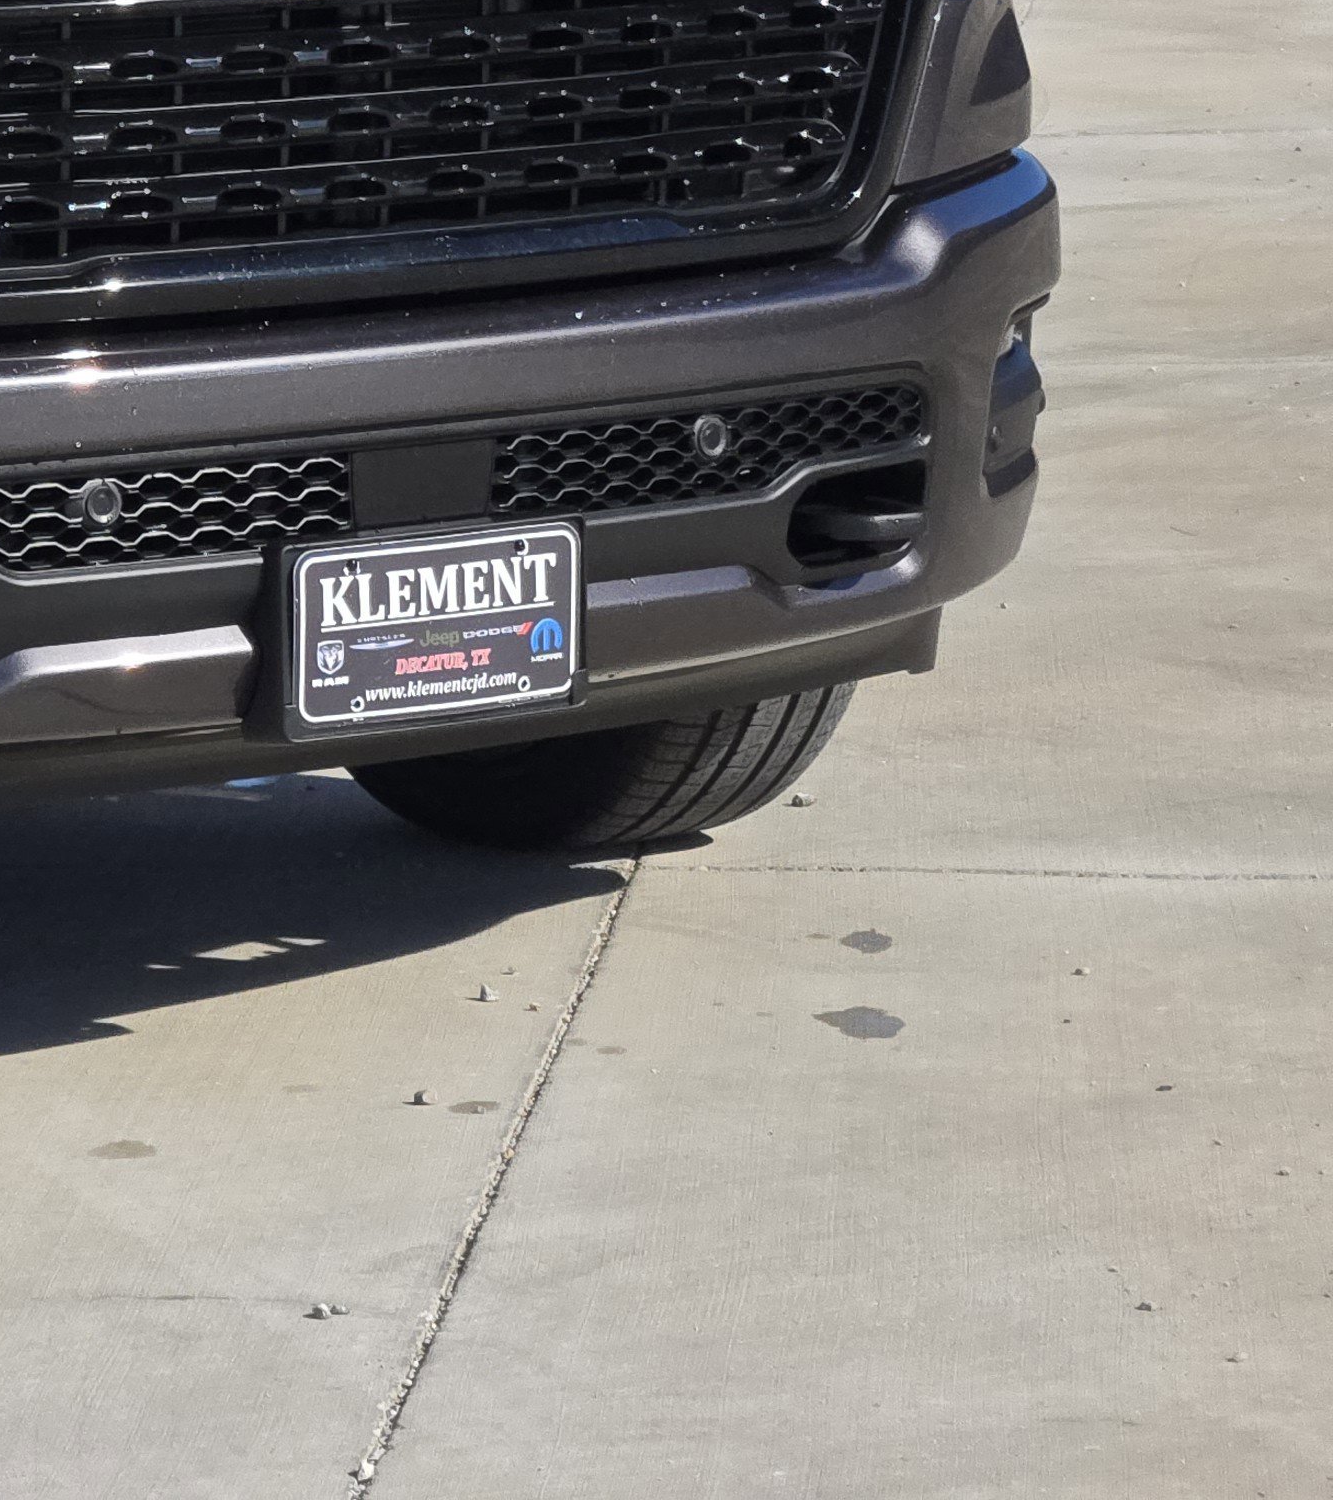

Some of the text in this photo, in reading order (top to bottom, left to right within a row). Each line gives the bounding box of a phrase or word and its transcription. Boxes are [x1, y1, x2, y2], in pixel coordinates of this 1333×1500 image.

[319, 553, 556, 627] KLEMENT
[419, 630, 460, 647] Jeep
[395, 648, 491, 675] DECATUR, TX
[365, 672, 517, 702] www.klementcjd.com
